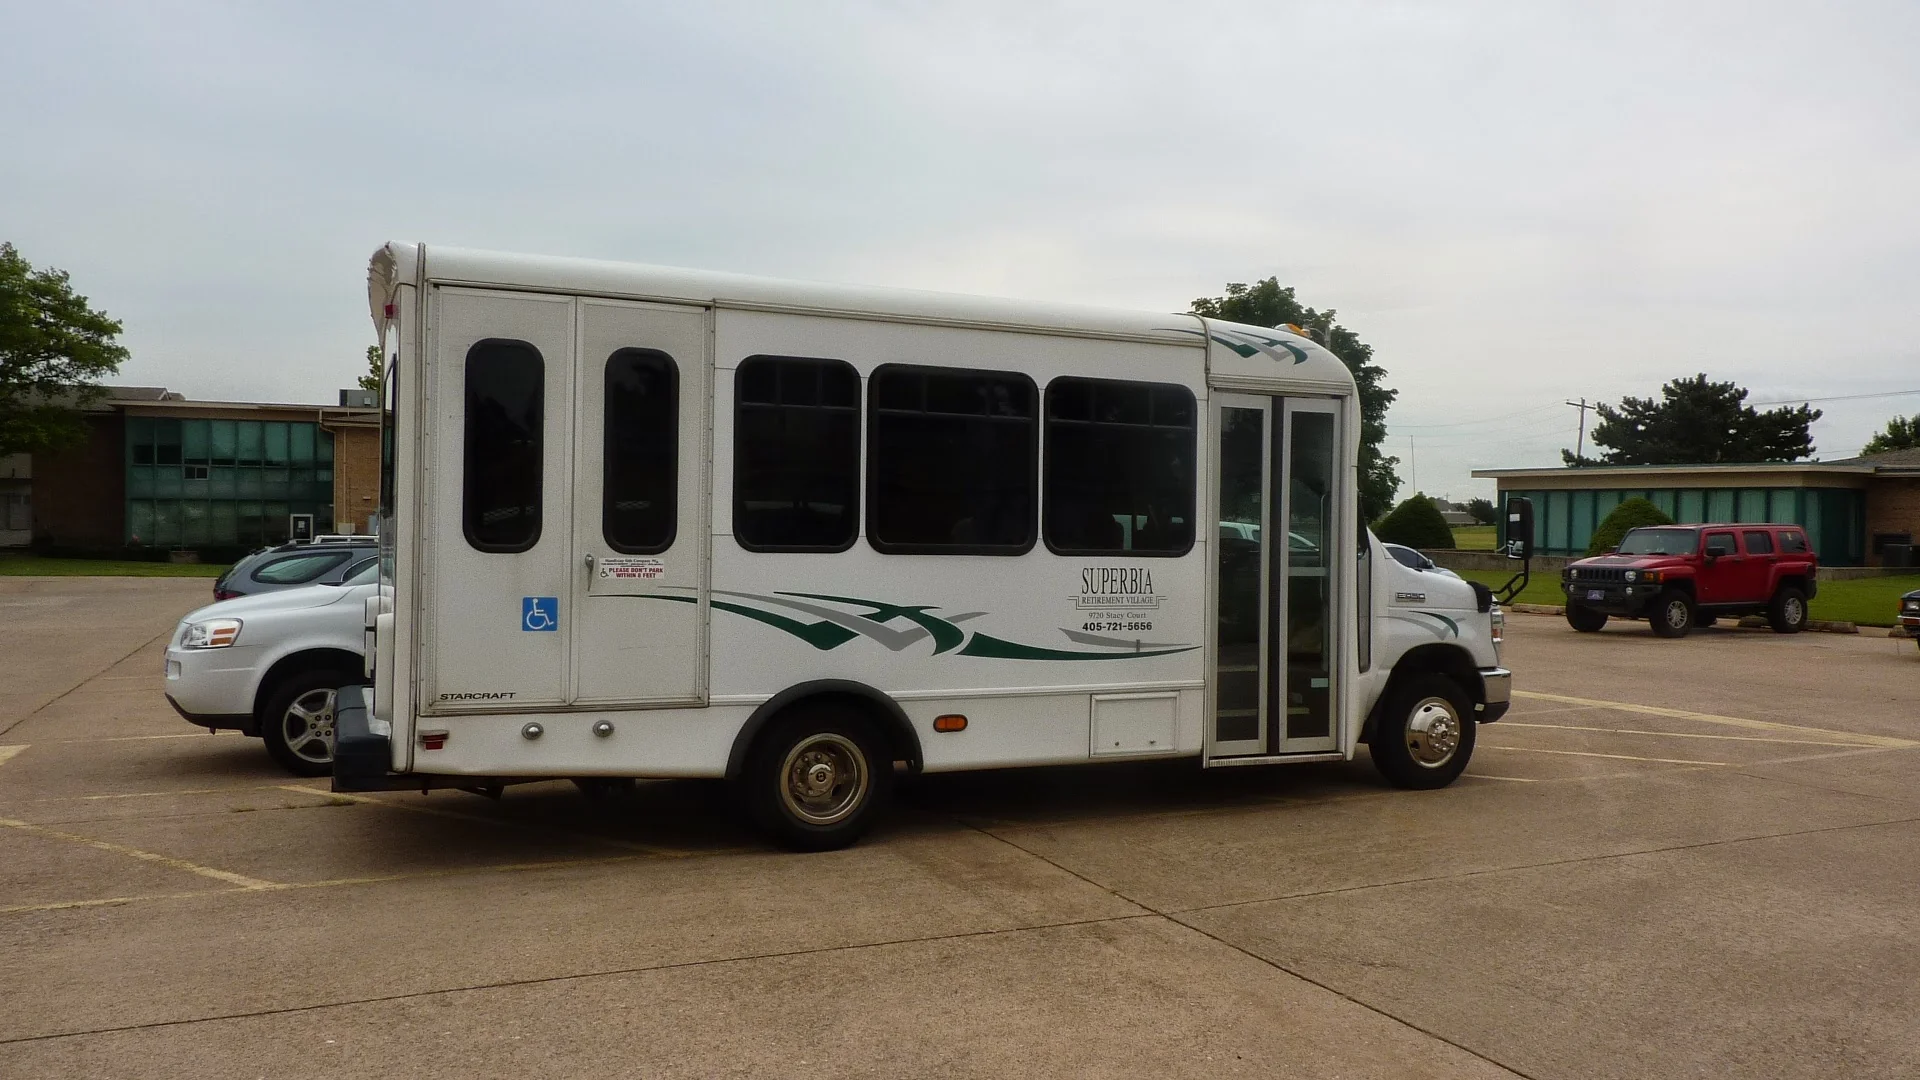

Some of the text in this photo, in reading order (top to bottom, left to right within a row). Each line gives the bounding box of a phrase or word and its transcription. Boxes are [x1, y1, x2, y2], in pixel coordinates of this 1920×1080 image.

[1082, 568, 1154, 594] SUPERBIA
[1106, 612, 1124, 620] Stacy
[1082, 622, 1152, 631] 405-721-5656
